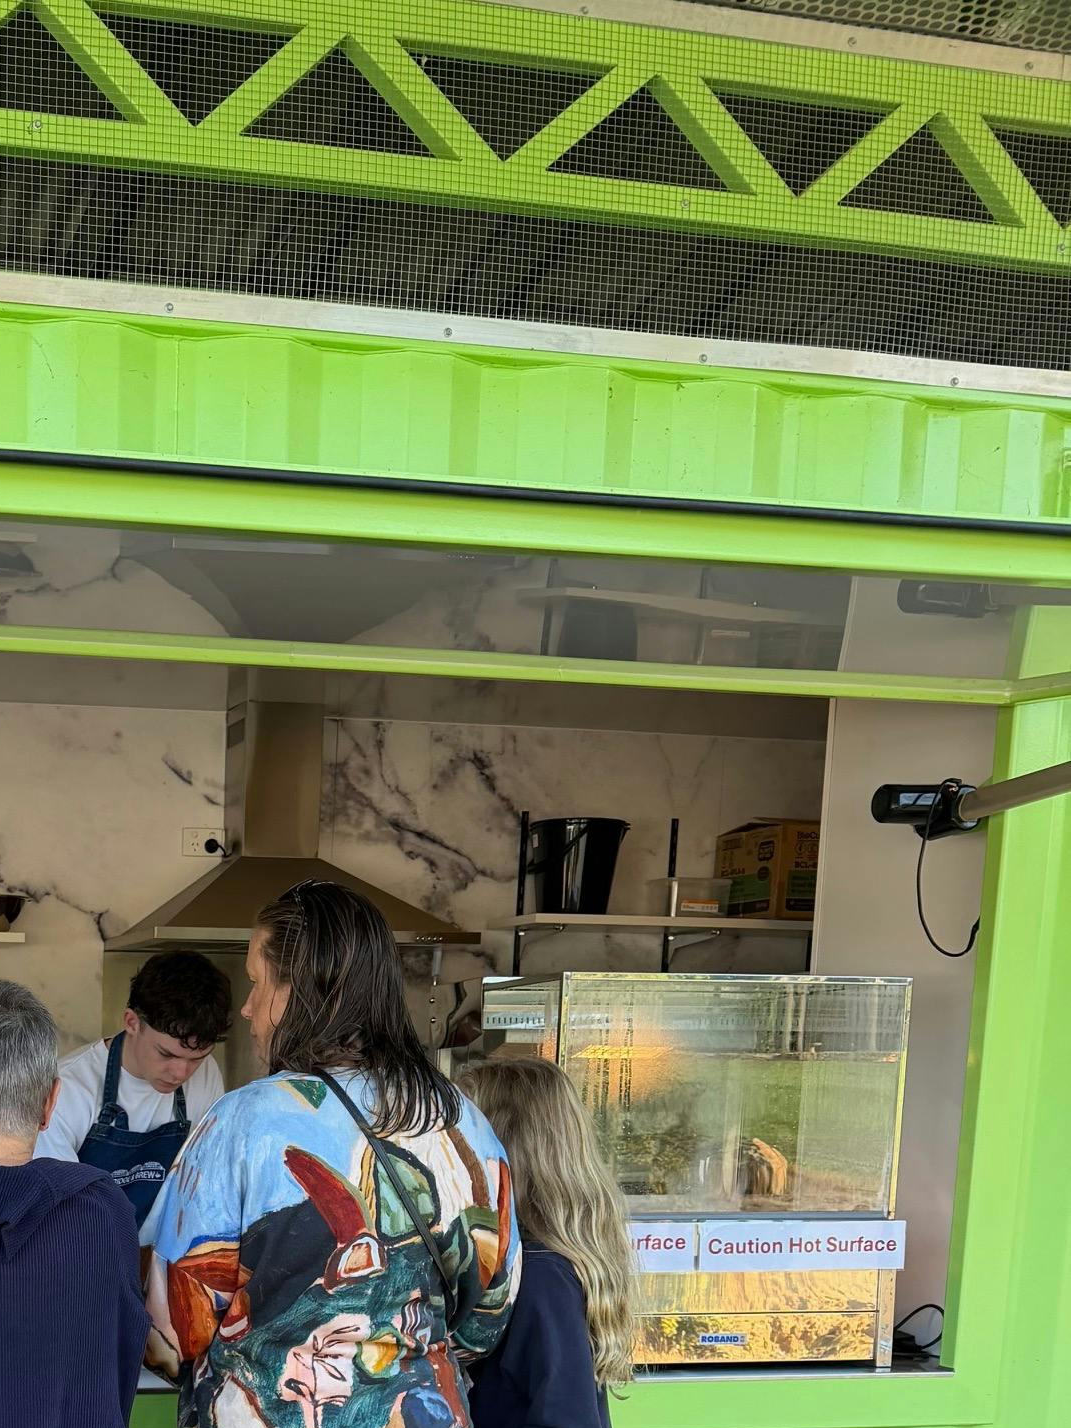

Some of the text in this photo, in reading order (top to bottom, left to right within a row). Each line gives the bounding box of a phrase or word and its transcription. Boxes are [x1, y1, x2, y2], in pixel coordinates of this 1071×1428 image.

[631, 1234, 686, 1250] rface
[708, 1236, 897, 1255] Caution Hot Surface
[701, 1335, 739, 1343] ROBAND
